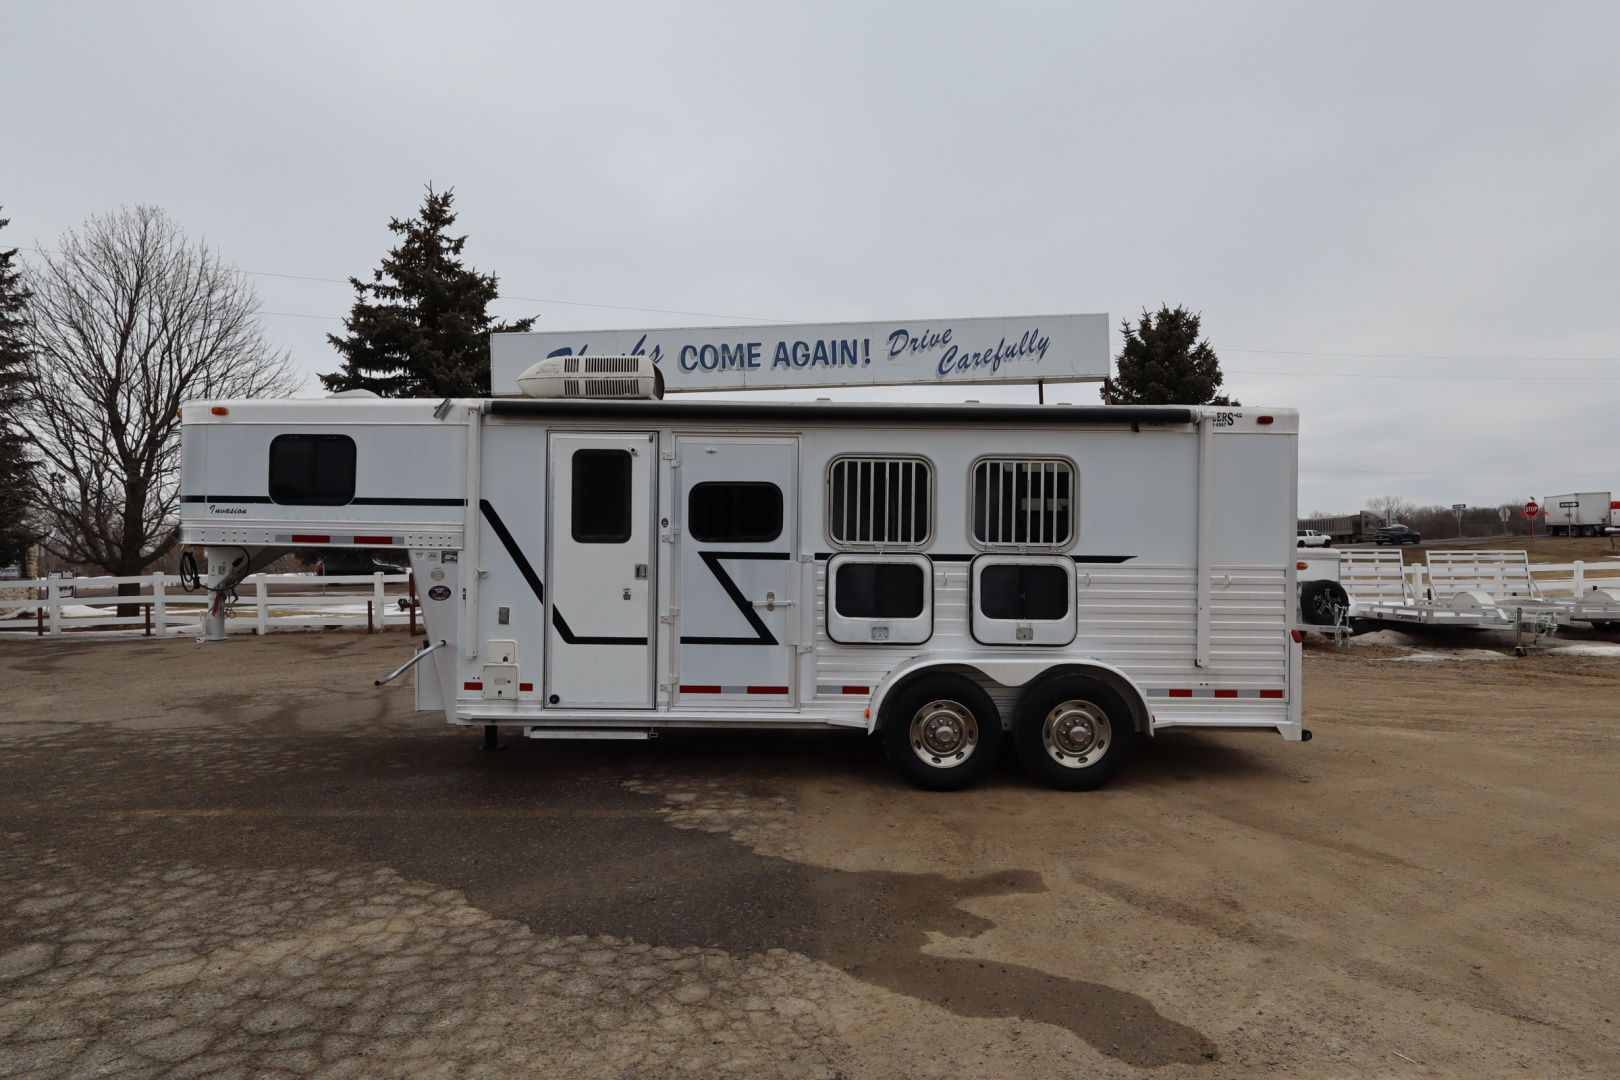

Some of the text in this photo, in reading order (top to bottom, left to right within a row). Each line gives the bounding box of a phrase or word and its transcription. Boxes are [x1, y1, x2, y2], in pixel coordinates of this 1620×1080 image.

[679, 342, 762, 371] COME
[772, 338, 872, 368] AGAIN!
[888, 328, 953, 357] Drive
[938, 327, 1050, 376] Carefully
[209, 504, 248, 515] Invasion
